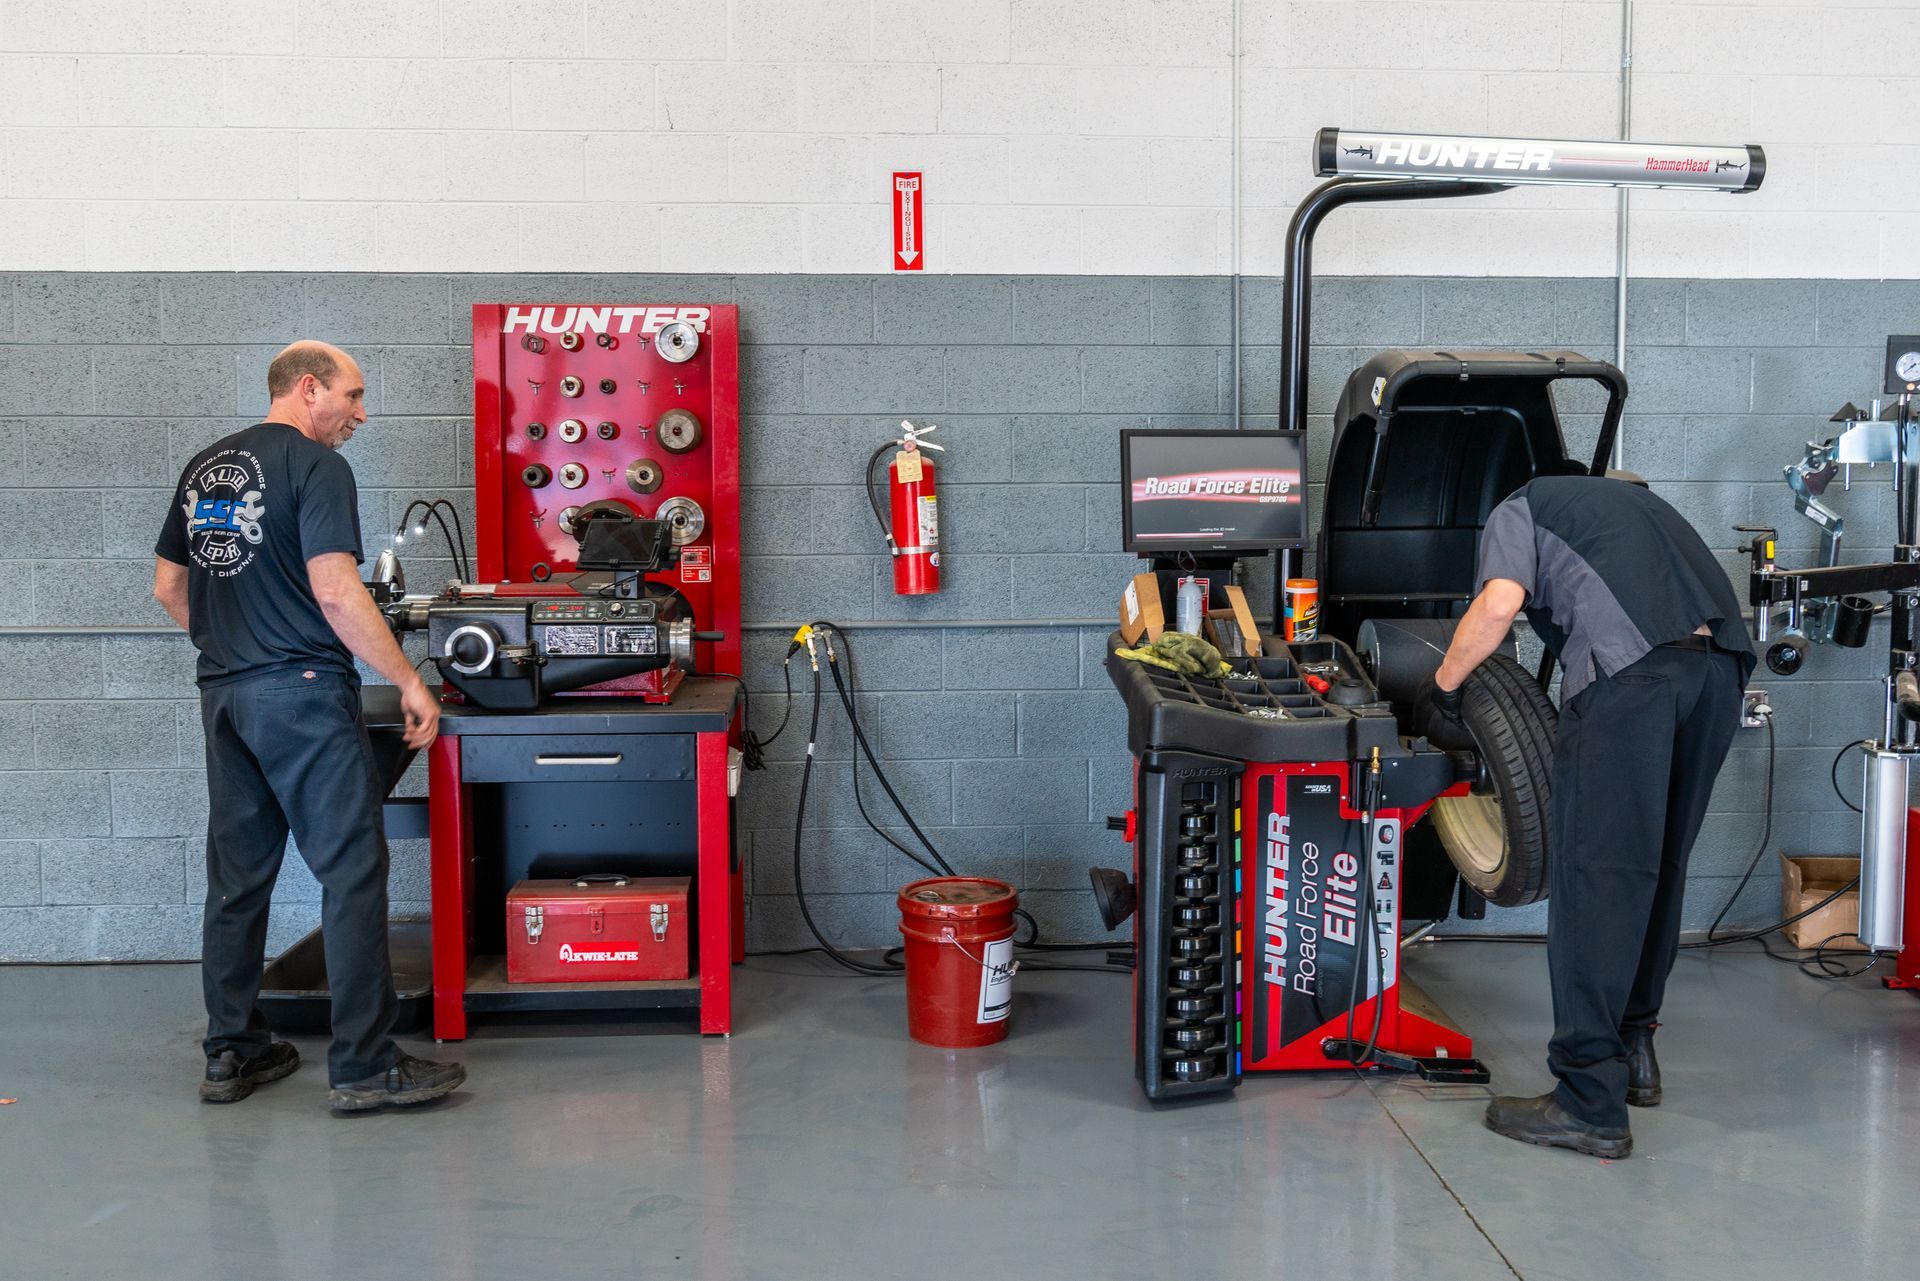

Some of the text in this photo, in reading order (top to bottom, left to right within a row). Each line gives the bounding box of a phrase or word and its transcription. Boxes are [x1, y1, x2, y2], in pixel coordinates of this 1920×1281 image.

[1375, 142, 1553, 171] HUNTER
[1645, 156, 1710, 173] HammerHead
[898, 181, 917, 189] FIRE
[503, 307, 711, 333] HUNTER
[185, 449, 267, 491] TECHNOLOGY AND SERVICE
[205, 468, 245, 487] AUTO
[1145, 477, 1290, 495] Road Force Elite
[1315, 784, 1331, 792] USA
[1264, 812, 1290, 987] HUNTER
[1324, 852, 1358, 946] Elite
[1294, 841, 1319, 996] Road Force
